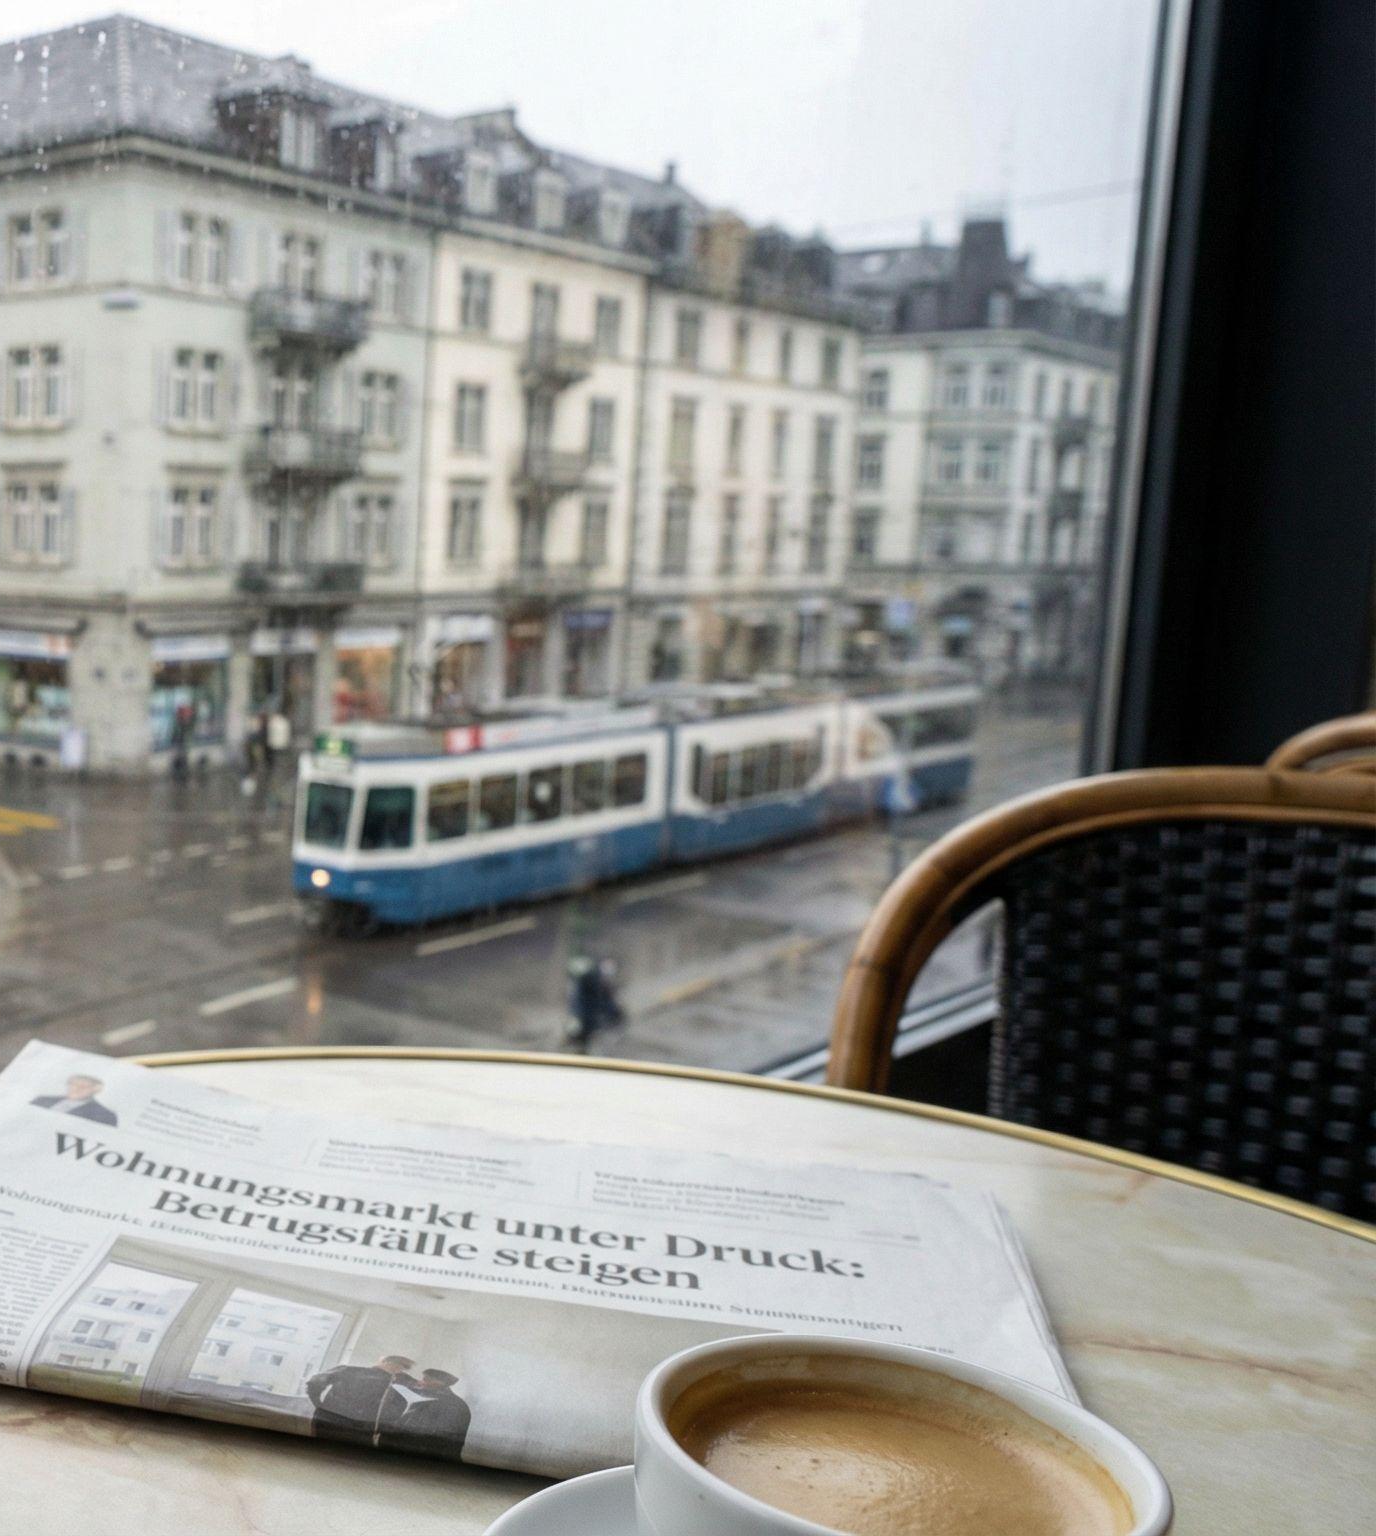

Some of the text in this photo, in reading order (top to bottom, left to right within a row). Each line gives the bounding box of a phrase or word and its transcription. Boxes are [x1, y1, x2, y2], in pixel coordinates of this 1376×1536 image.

[54, 1132, 477, 1232] Wohnungsmarkt
[495, 1217, 647, 1251] unter
[665, 1234, 866, 1279] Druck:
[150, 1189, 478, 1260] Betrugsfälle
[492, 1246, 702, 1289] steigen
